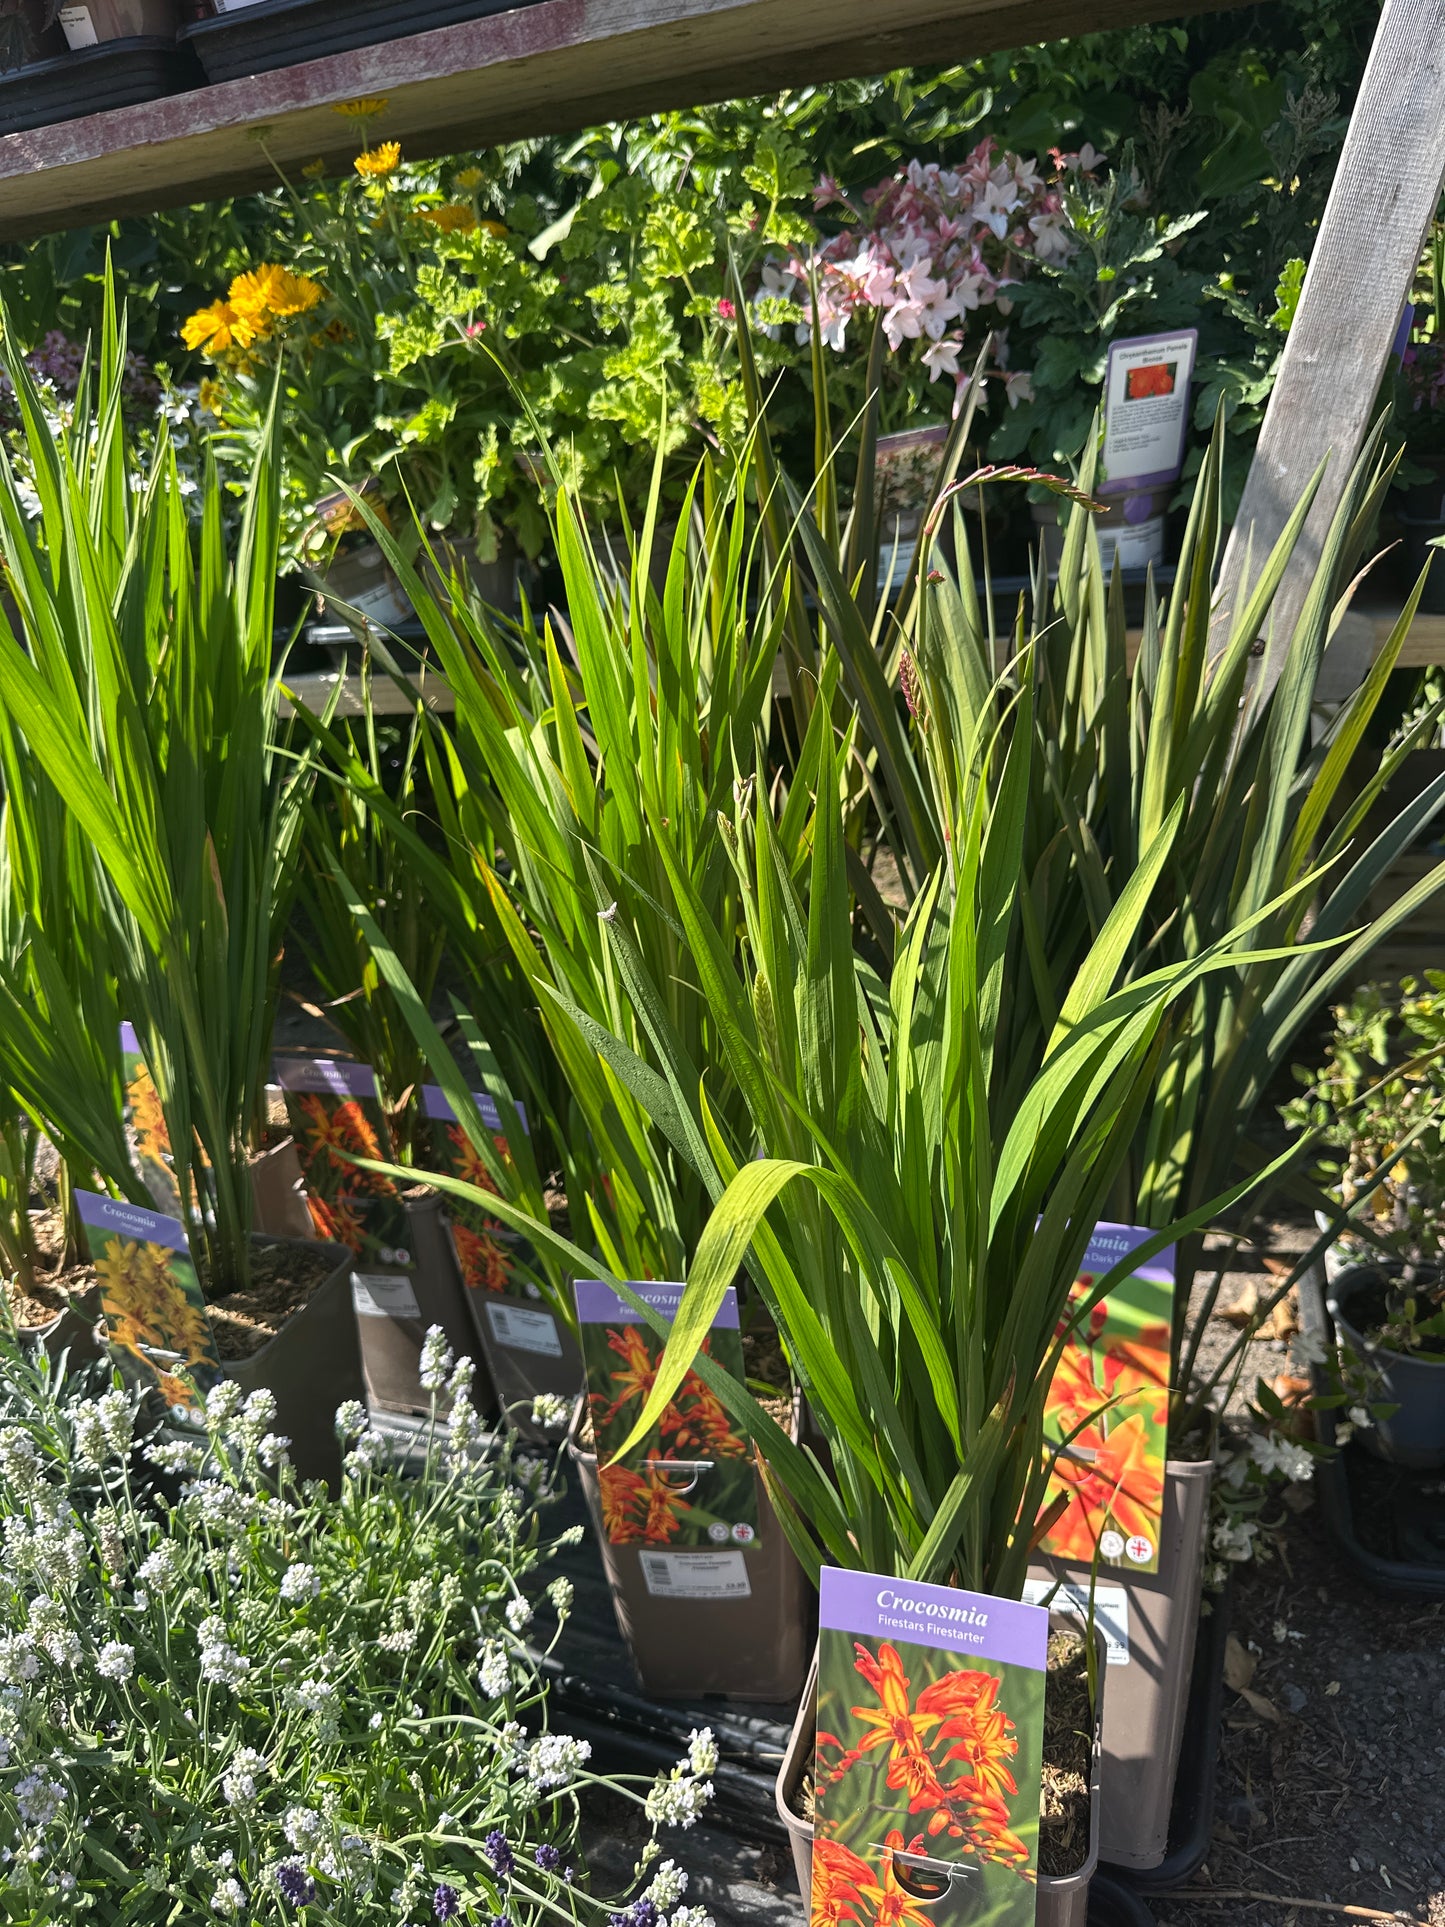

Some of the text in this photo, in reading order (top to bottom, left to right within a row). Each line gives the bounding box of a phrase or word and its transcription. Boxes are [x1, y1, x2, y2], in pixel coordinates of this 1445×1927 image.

[103, 1204, 156, 1228] Crocosmia
[876, 1590, 989, 1627] Crocosmia
[878, 1613, 985, 1645] Firestars Firestarter
